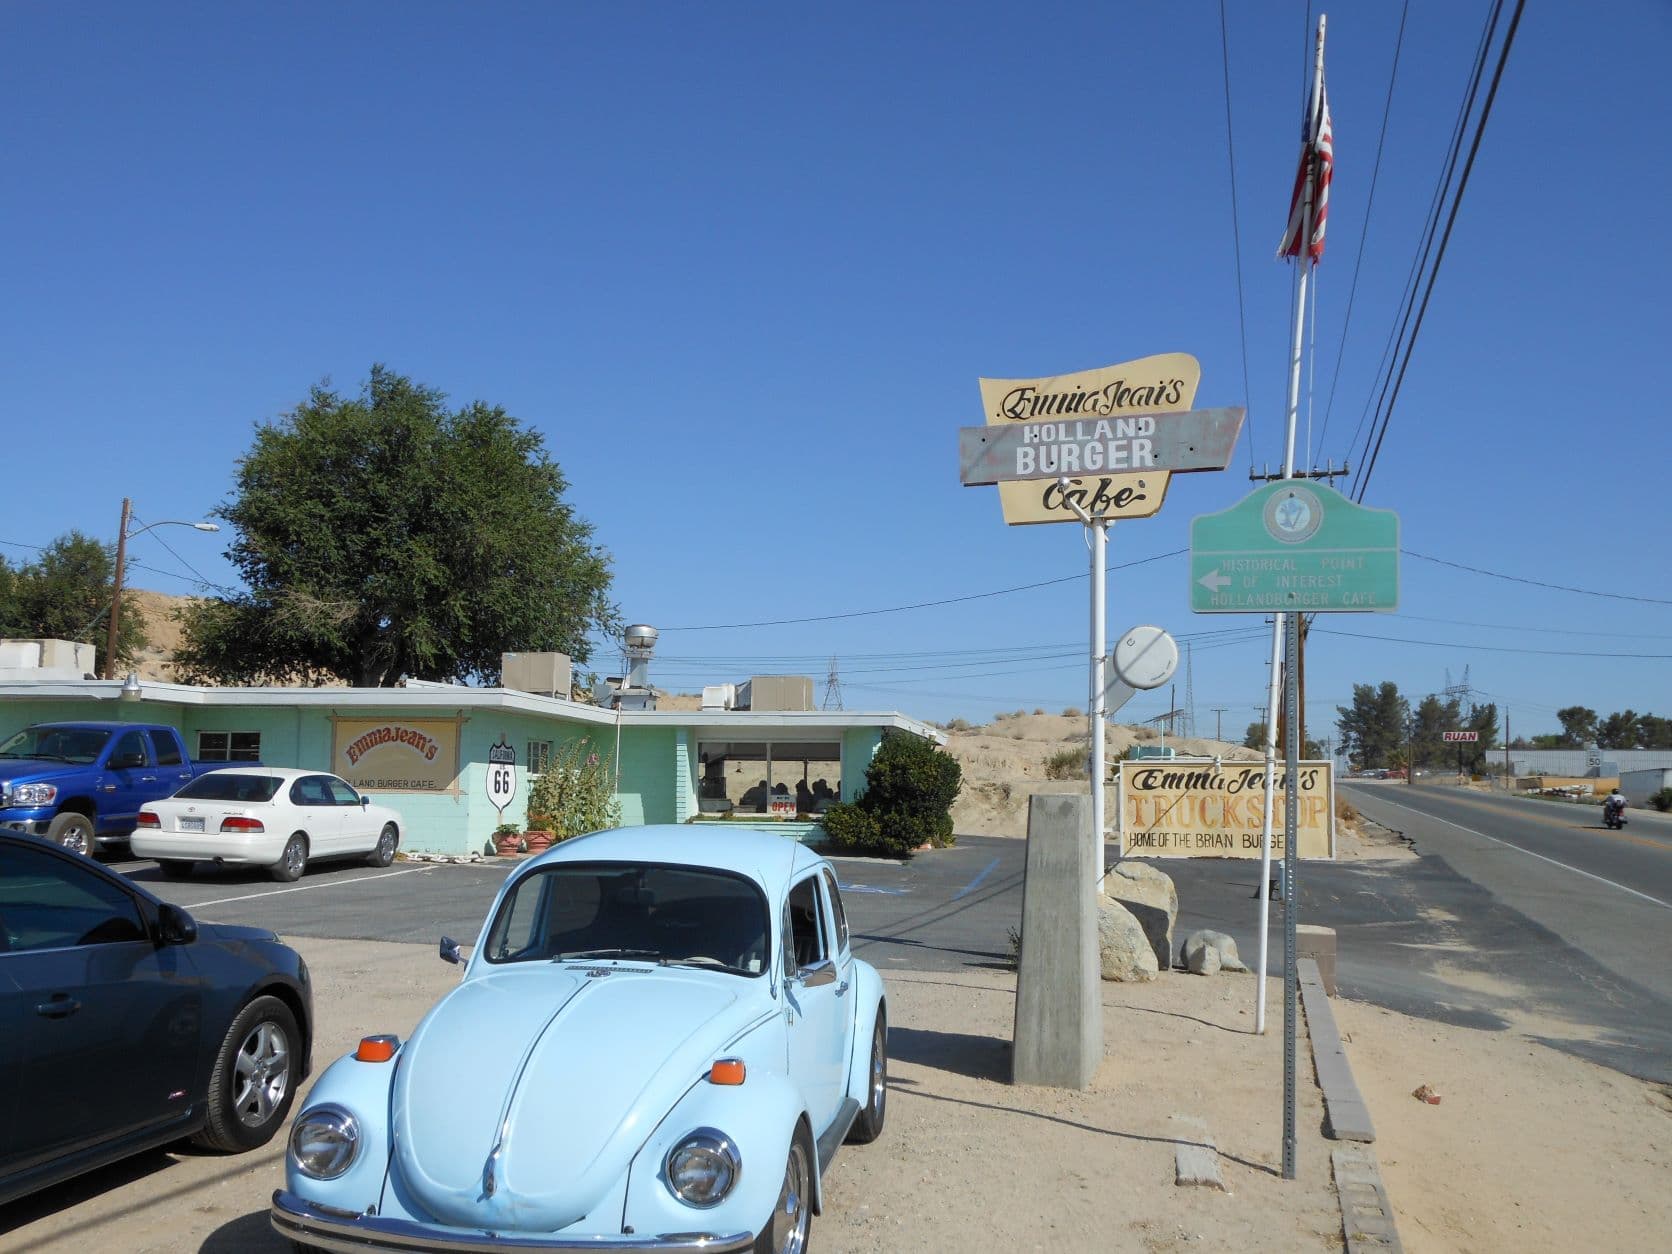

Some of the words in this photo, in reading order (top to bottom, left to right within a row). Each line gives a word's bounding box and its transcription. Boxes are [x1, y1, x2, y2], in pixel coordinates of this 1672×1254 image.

[1023, 416, 1156, 444] HOLLAND
[1016, 438, 1155, 475] BURGER
[1223, 558, 1297, 572] HISTORICAL
[1321, 557, 1366, 570] POINT
[1243, 576, 1258, 588] OF
[1276, 574, 1345, 588] INTEREST
[1342, 591, 1377, 605] CAFE
[1444, 732, 1477, 741] RUAN
[1589, 758, 1601, 766] 50
[377, 779, 409, 788] BURGER
[494, 770, 510, 794] 66
[771, 801, 796, 812] OPEN
[1129, 832, 1157, 847] HOME
[1158, 832, 1170, 847] OF
[1173, 832, 1192, 848] THE
[1195, 833, 1233, 848] BRIAN
